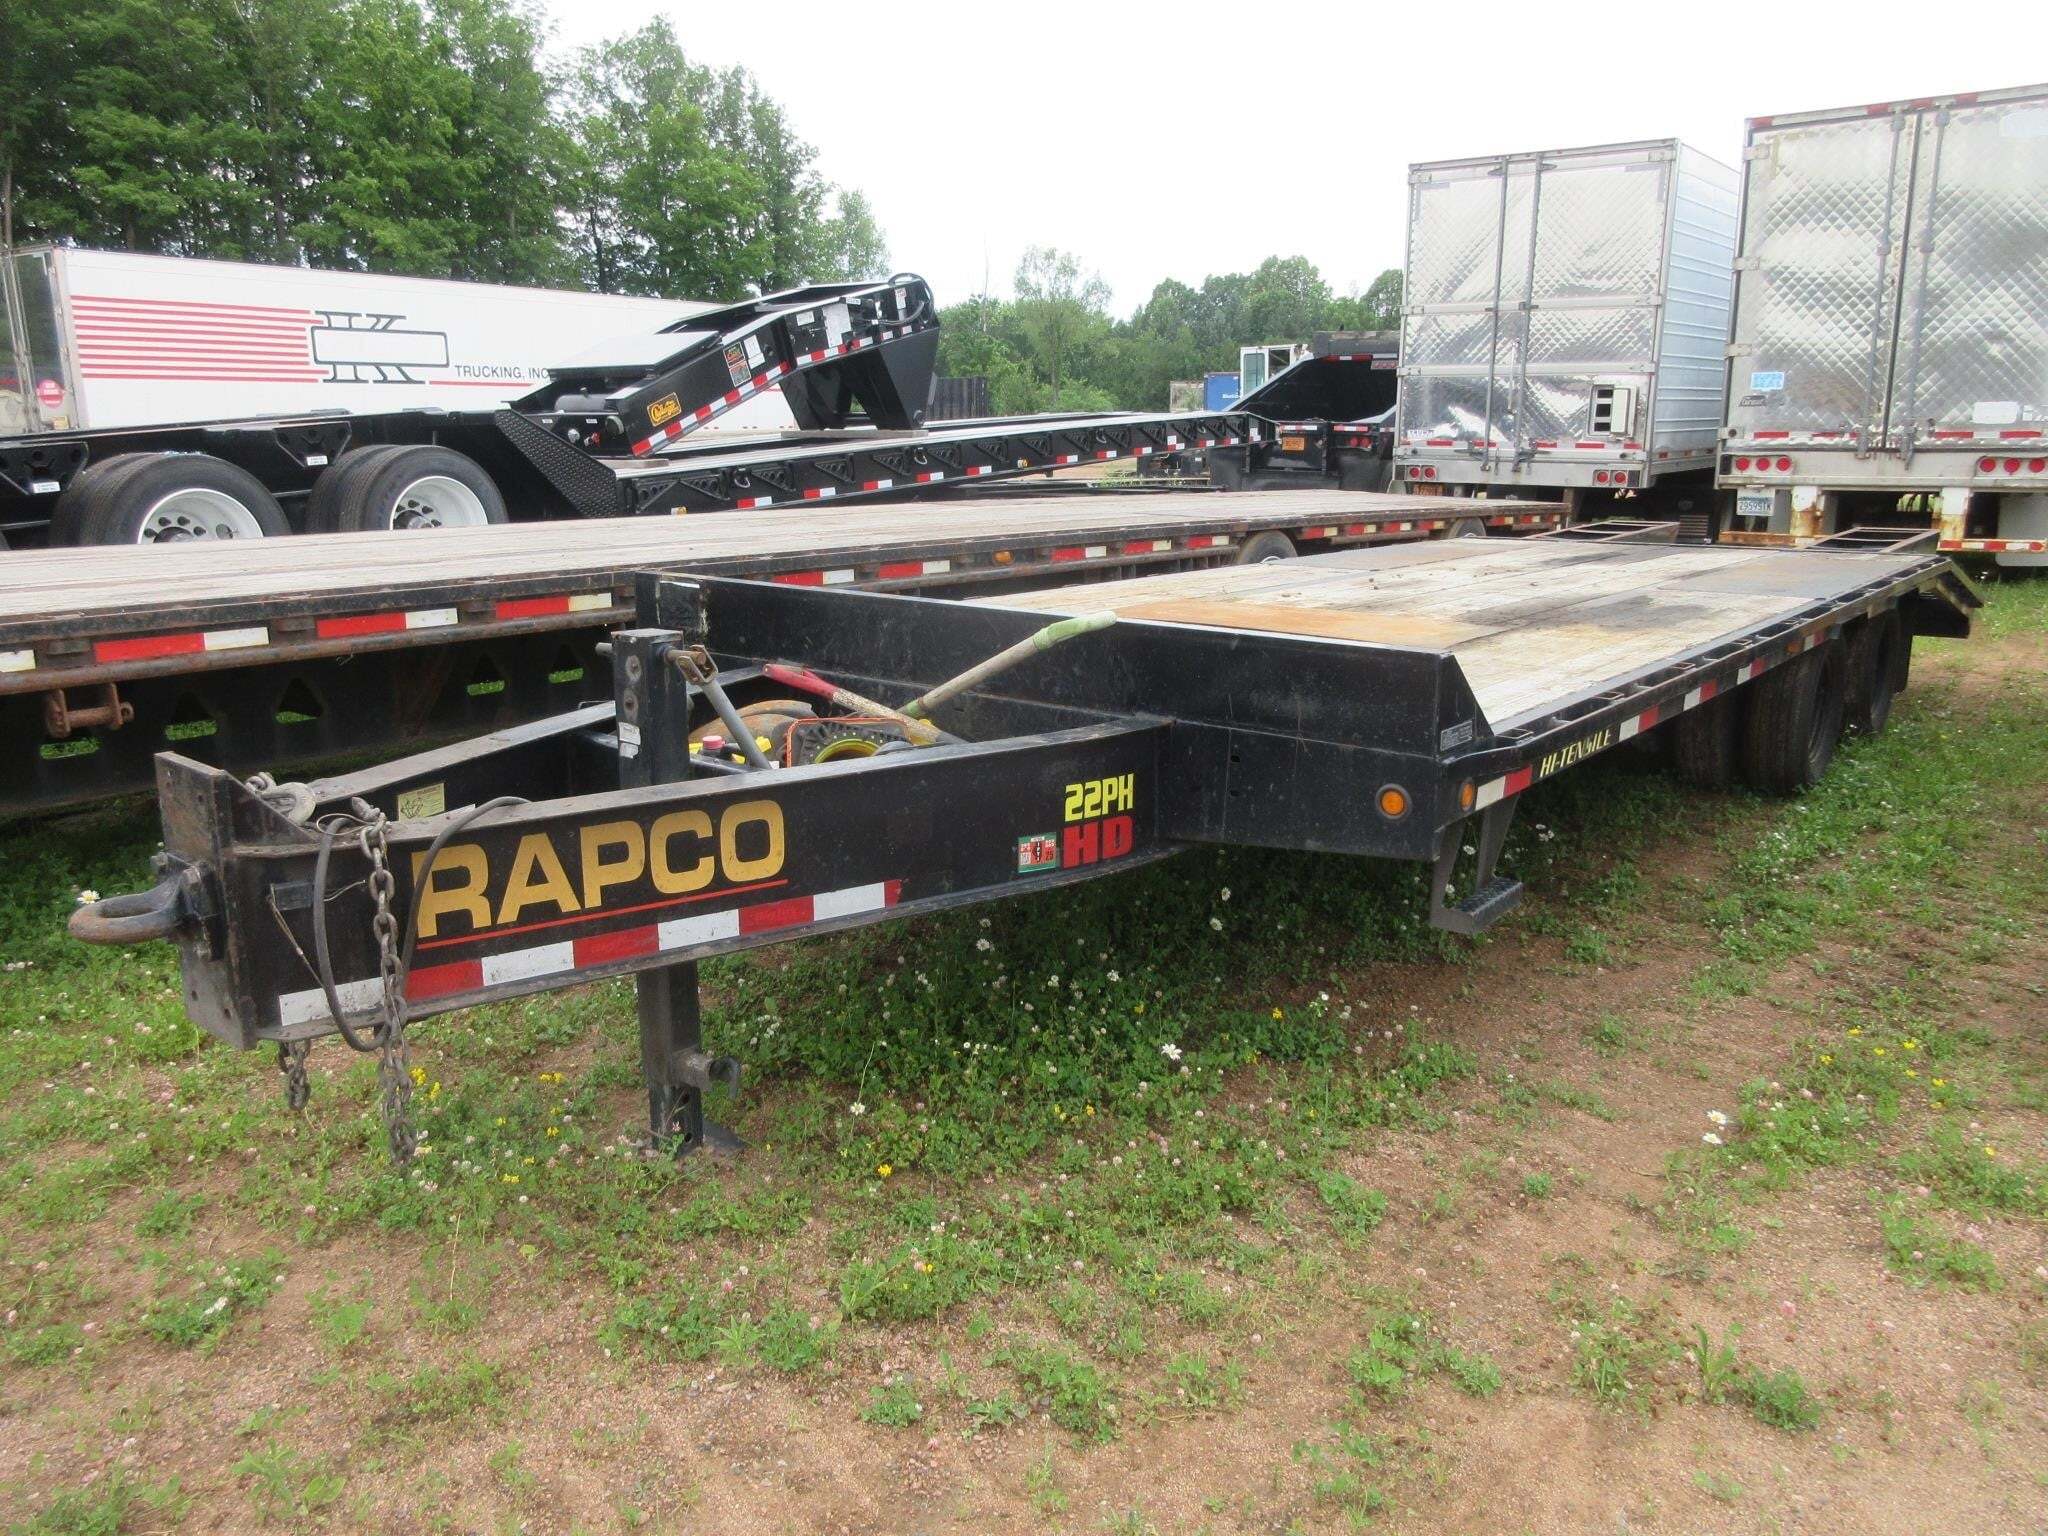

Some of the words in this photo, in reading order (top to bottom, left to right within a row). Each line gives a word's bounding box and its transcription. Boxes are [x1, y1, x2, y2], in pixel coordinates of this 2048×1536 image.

[455, 365, 525, 381] TRUCKING,
[1065, 773, 1134, 822] 22PH
[1063, 815, 1132, 869] HD
[411, 800, 785, 938] RAPCO
